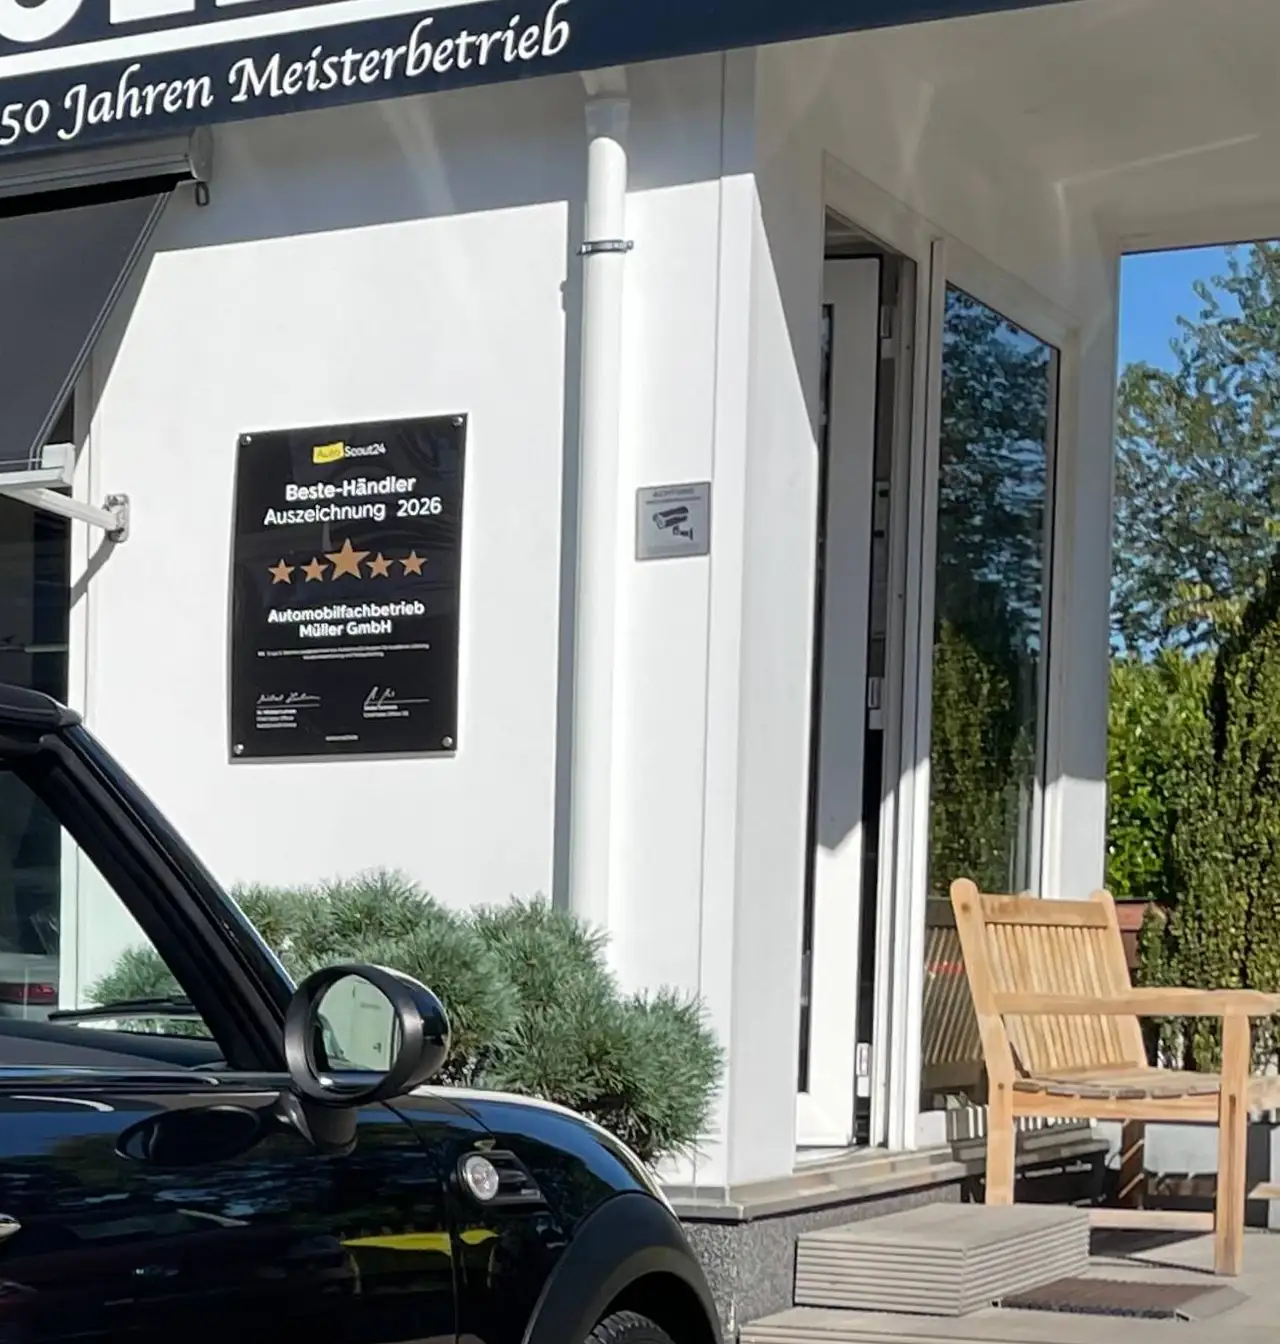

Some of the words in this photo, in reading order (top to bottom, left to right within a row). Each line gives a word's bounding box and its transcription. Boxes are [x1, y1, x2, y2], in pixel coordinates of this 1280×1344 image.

[57, 63, 213, 140] Jahren
[228, 0, 570, 103] Meisterbetrieb
[285, 475, 417, 501] Beste-Händler
[263, 502, 386, 526] Auszeichnung
[396, 496, 443, 517] 2026
[268, 600, 425, 623] Automobilfachbetrieb
[299, 623, 344, 638] Müller
[346, 620, 392, 635] GmbH
